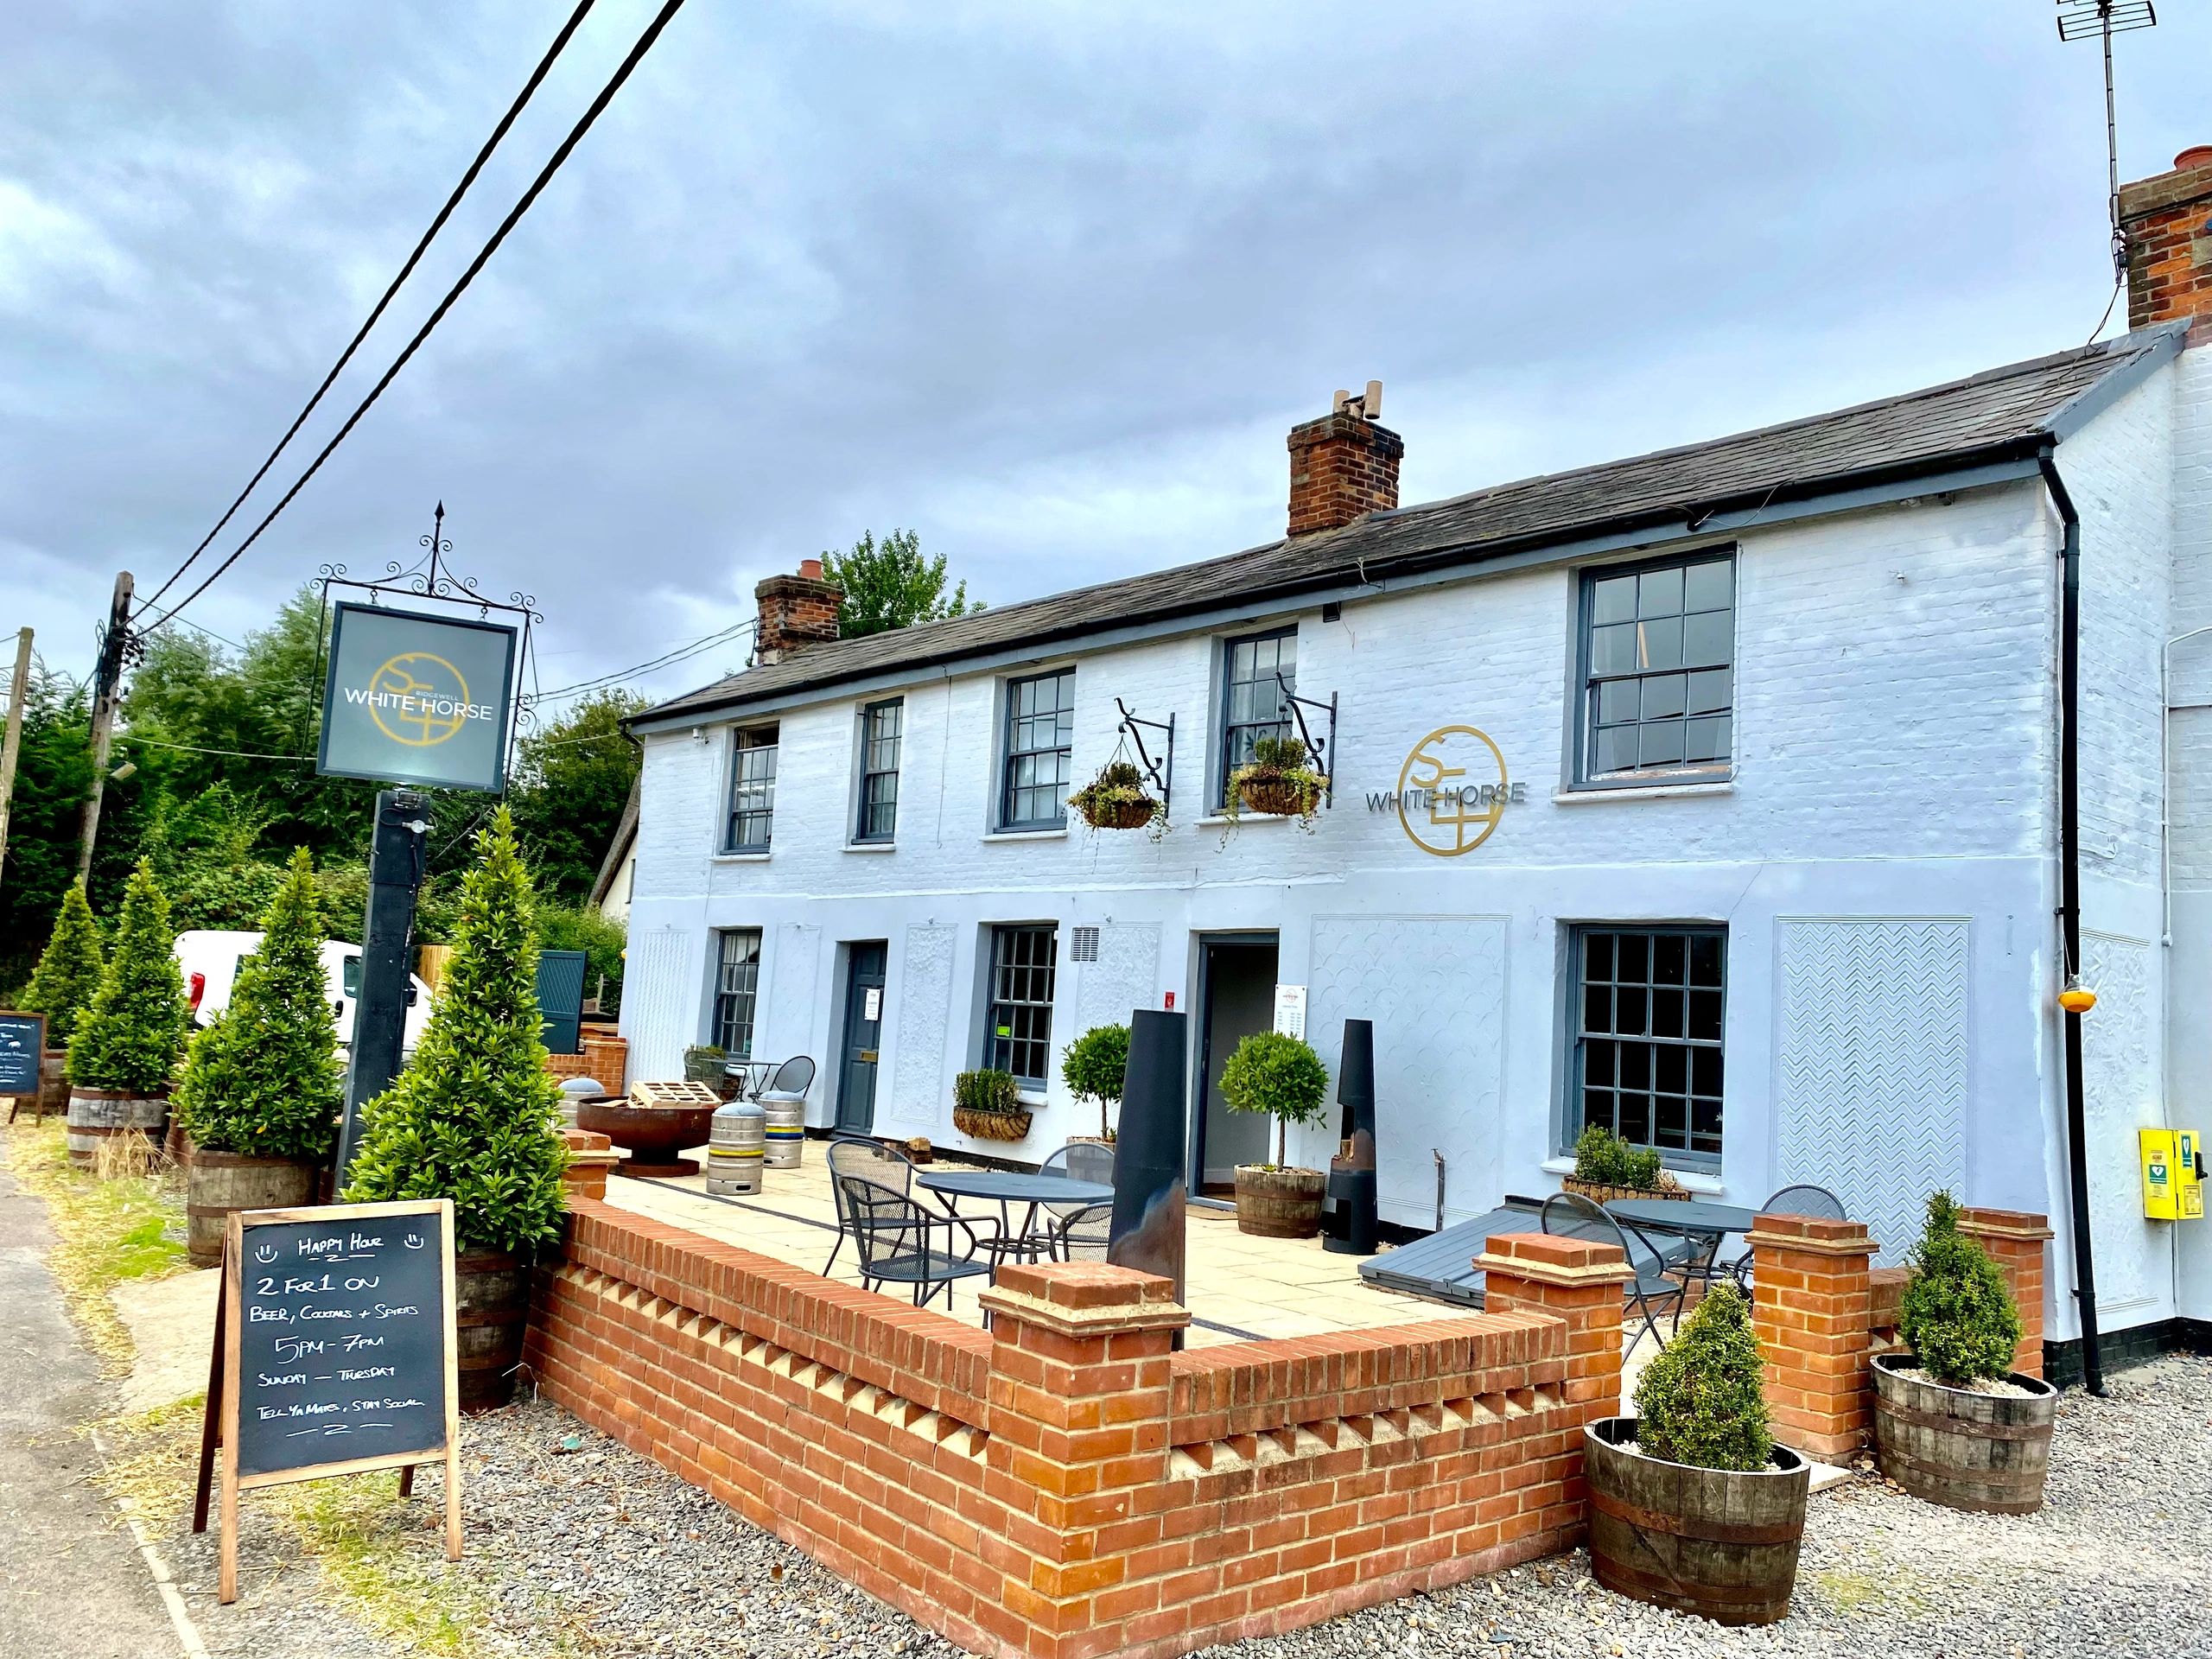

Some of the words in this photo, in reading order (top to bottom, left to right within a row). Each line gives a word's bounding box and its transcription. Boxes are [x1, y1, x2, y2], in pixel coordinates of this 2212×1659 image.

[345, 687, 416, 711] WHITE
[422, 697, 493, 721] HORSE
[416, 690, 459, 701] RIDGEWELL
[1365, 789, 1437, 811] WHITE
[1445, 782, 1526, 807] HORSE
[298, 1237, 342, 1255] HAPPY
[350, 1232, 385, 1250] HOUR
[257, 1277, 279, 1295] 2
[284, 1278, 318, 1294] FOR
[318, 1274, 336, 1291] 1
[344, 1276, 379, 1291] ON
[250, 1306, 296, 1325] BEER,
[374, 1303, 419, 1319] SPIRITS
[257, 1373, 306, 1387] SUNDAY
[257, 1406, 289, 1420] TELL
[352, 1400, 380, 1412] STAY
